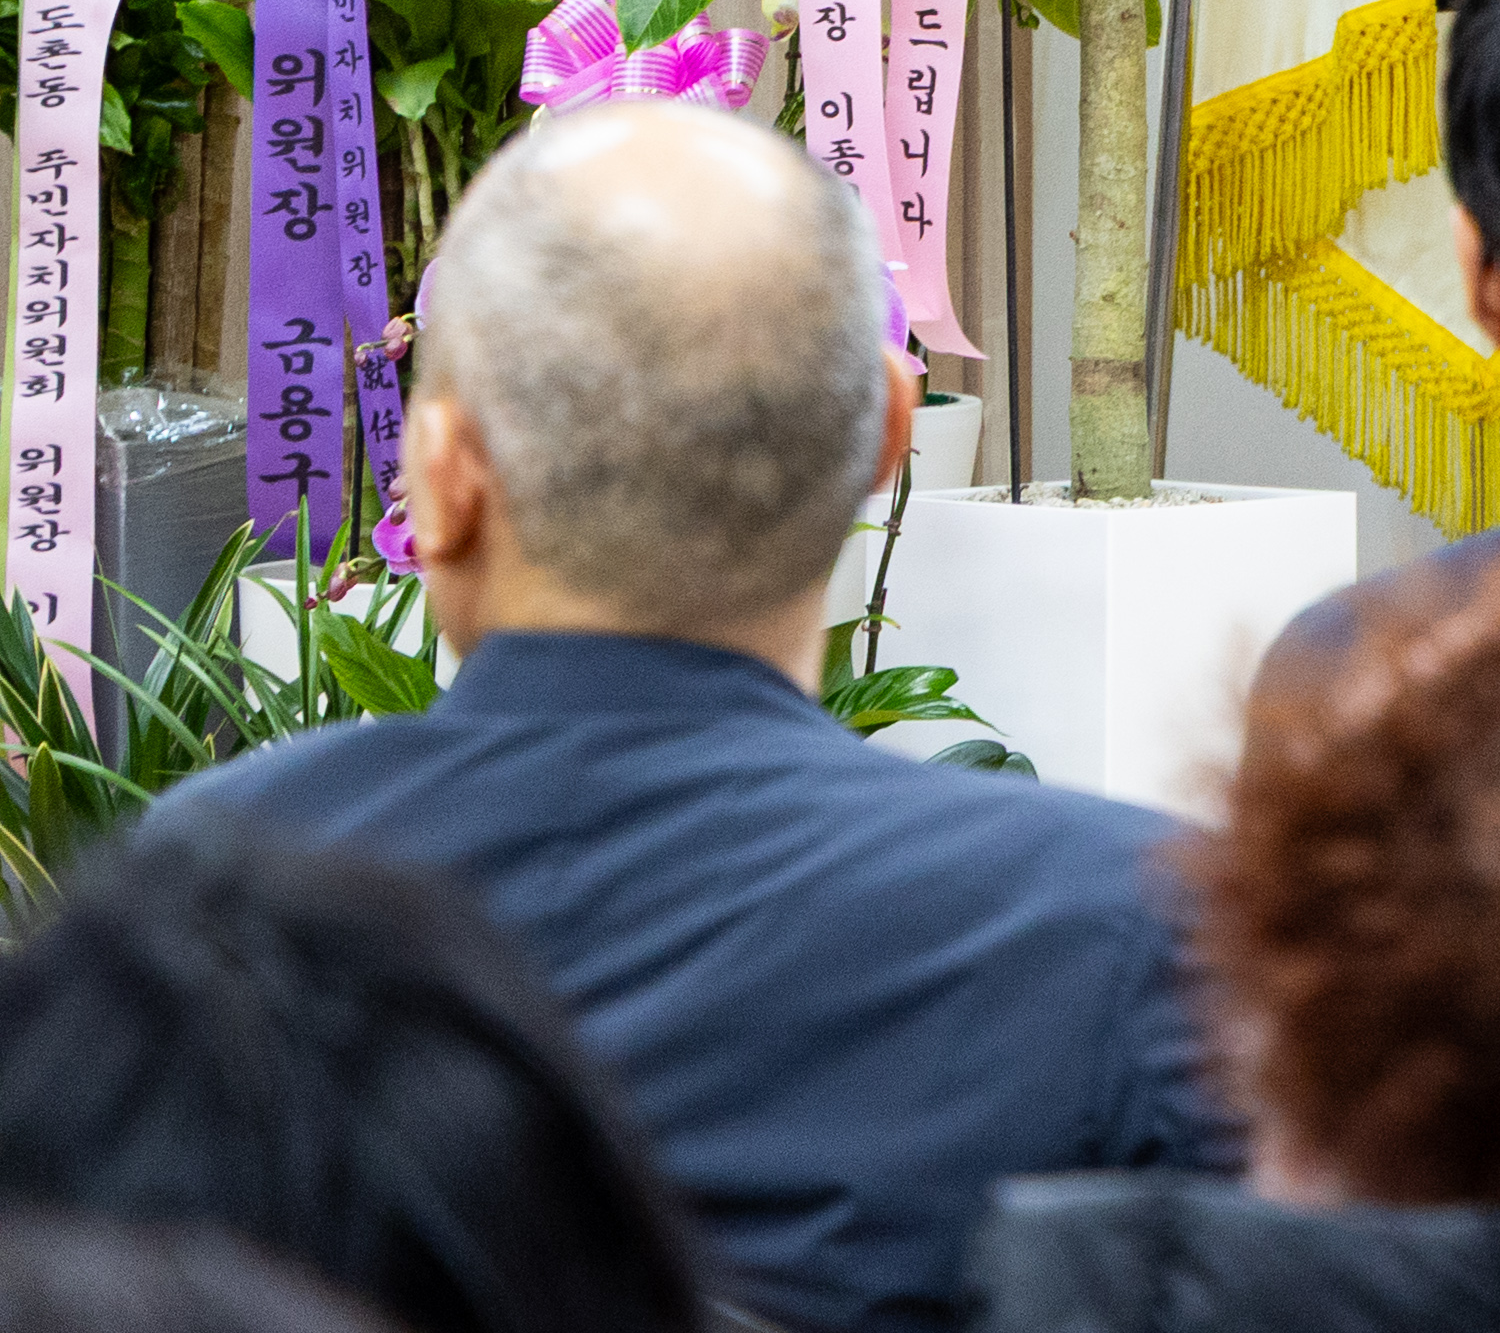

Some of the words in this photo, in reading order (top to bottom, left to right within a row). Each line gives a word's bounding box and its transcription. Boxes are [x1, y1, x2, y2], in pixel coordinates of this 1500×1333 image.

[26, 4, 86, 109] 도촌동
[261, 47, 333, 242] 위원장
[820, 91, 866, 195] 이종
[19, 148, 79, 403] 주민자치위원회
[17, 443, 71, 552] 위원장
